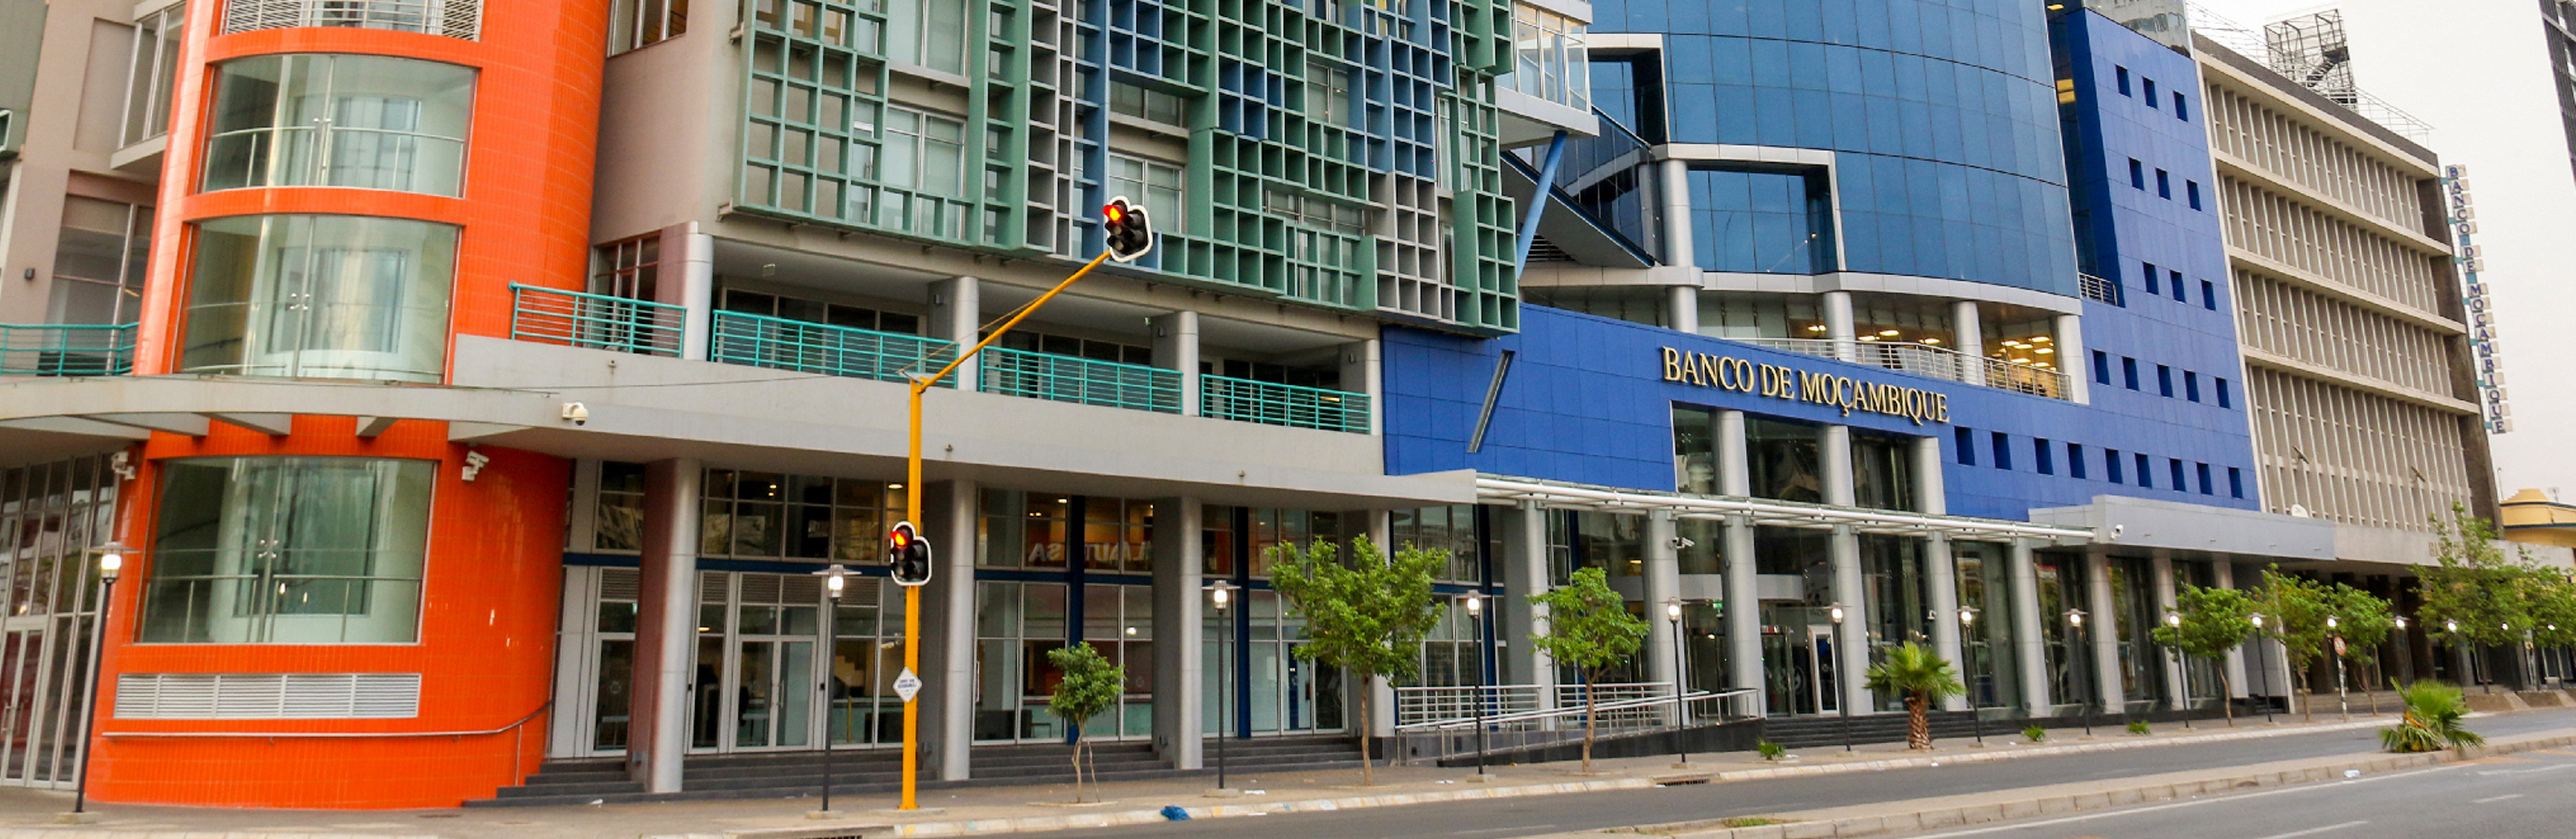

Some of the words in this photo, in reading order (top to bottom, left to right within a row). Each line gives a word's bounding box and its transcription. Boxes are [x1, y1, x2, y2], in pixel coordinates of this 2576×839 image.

[2448, 166, 2471, 235] BANCO
[2463, 246, 2477, 273] DE
[1662, 347, 1755, 393] BANCO
[1758, 363, 1795, 400] DE
[1798, 369, 1950, 426] MOÇAMBIQUE
